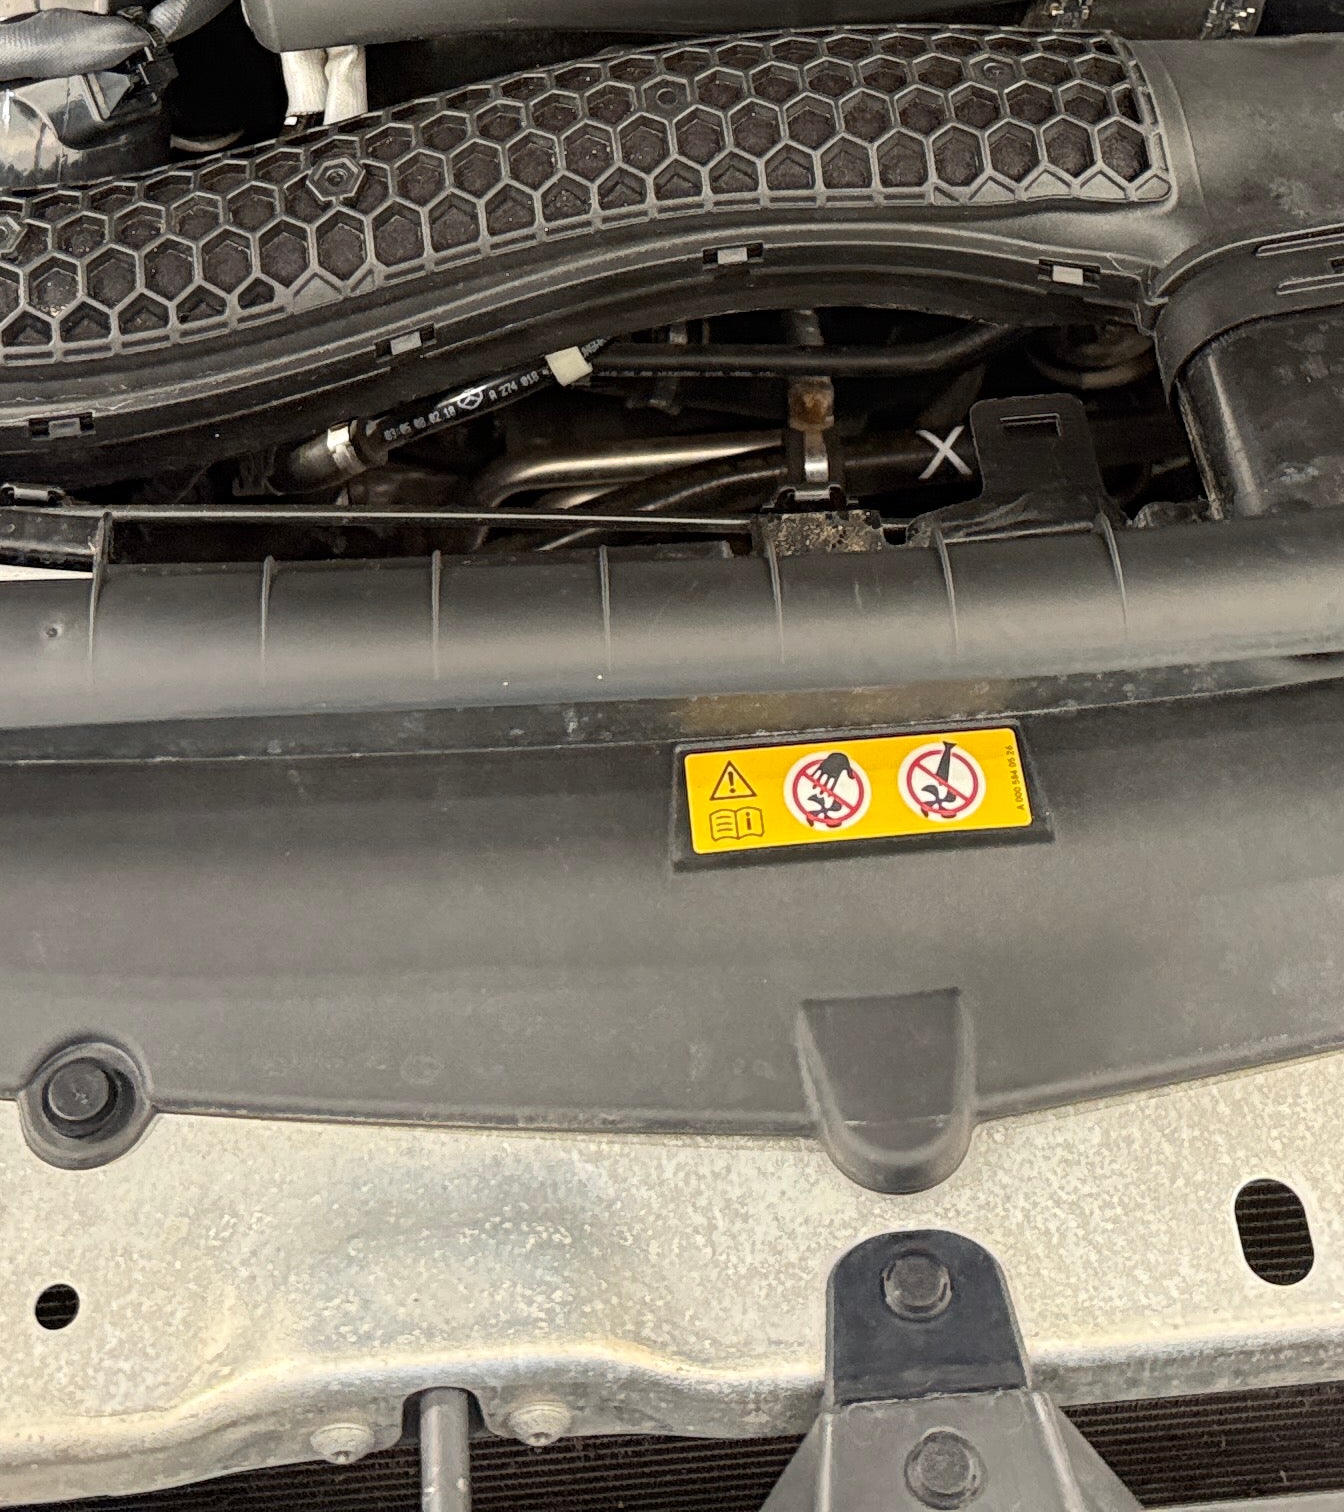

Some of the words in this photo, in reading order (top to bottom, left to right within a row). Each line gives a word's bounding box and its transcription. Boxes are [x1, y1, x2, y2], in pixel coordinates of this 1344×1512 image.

[488, 390, 498, 402] A
[499, 381, 518, 397] 274
[1010, 771, 1020, 785] 584
[1013, 787, 1023, 802] 000
